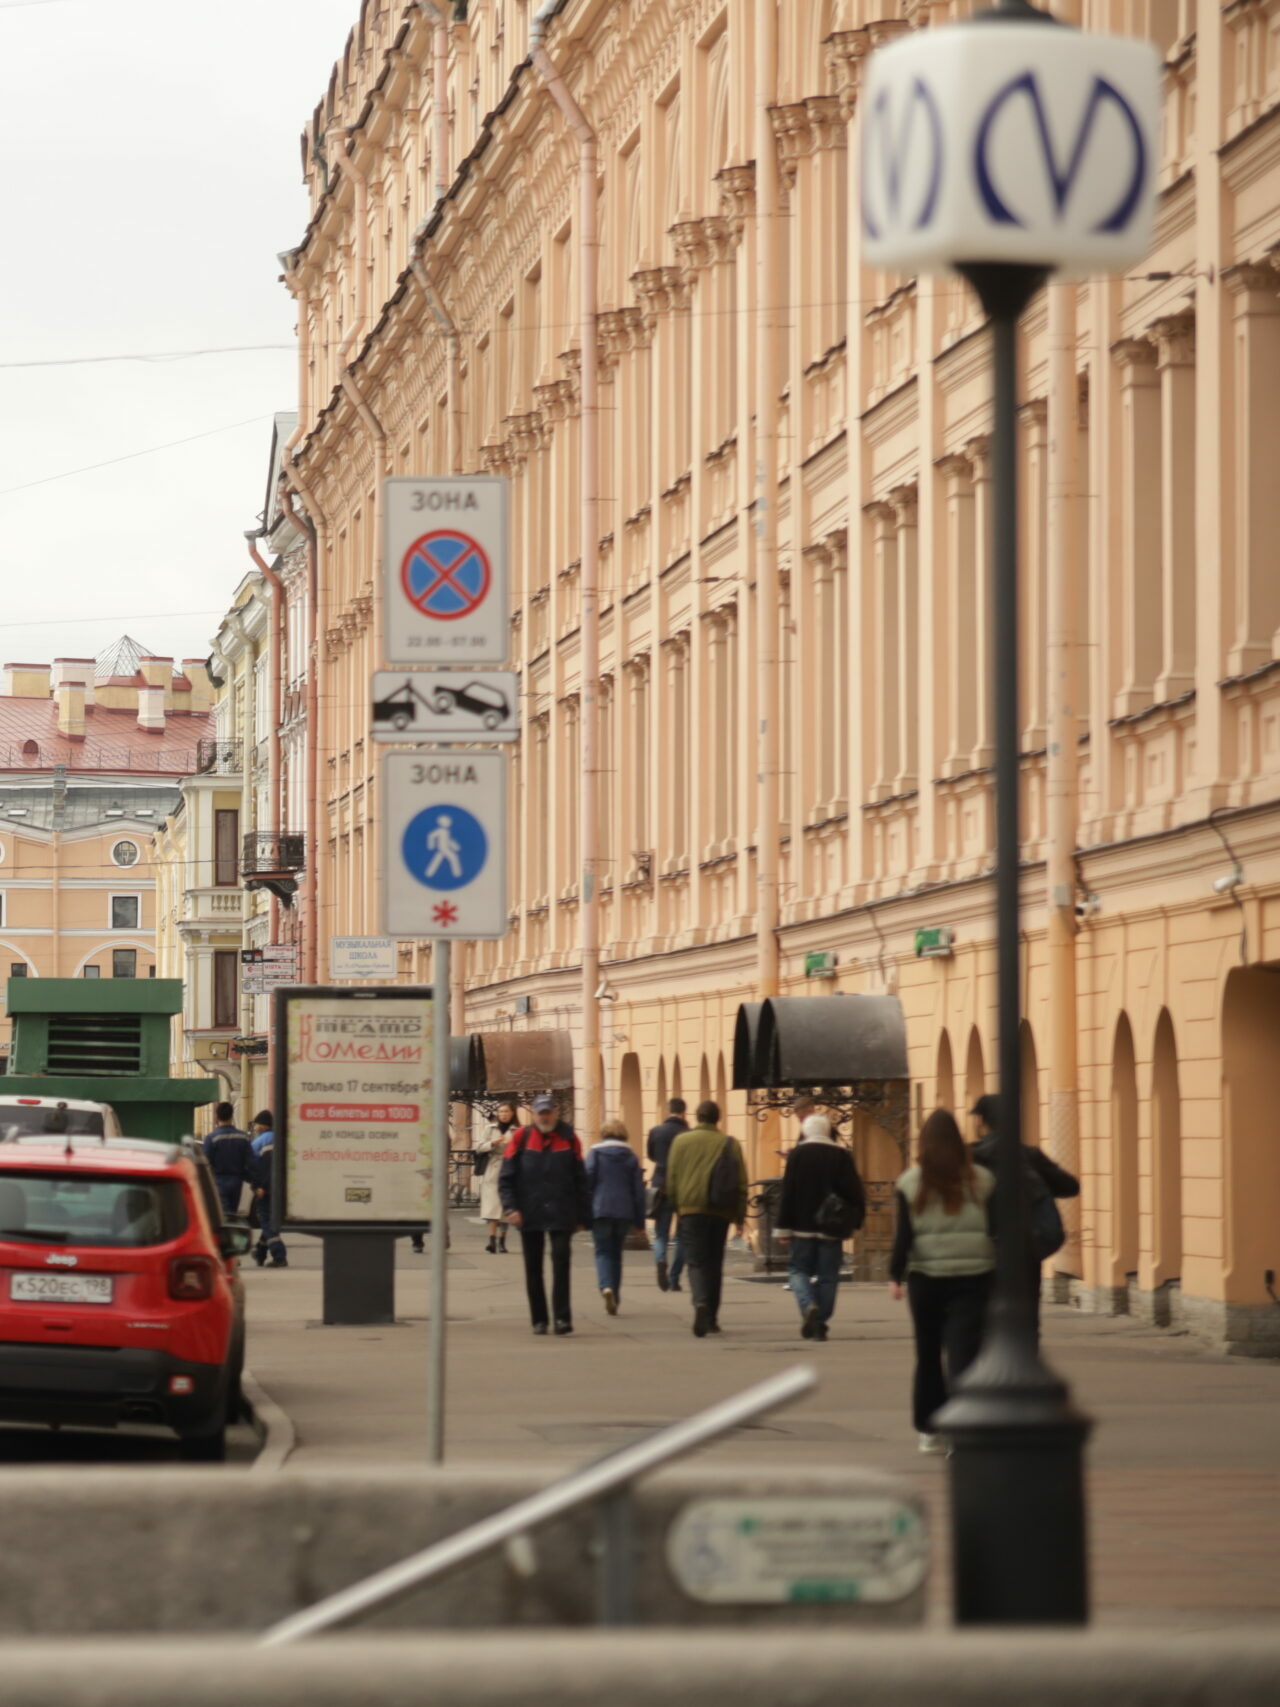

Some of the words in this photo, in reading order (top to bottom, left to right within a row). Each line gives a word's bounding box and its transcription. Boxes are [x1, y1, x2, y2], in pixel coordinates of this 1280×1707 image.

[411, 490, 479, 512] ЗОНА
[411, 764, 478, 785] ЗОНА
[348, 952, 378, 960] ШКОЛА
[300, 1081, 343, 1093] только
[347, 1080, 358, 1092] 17
[361, 1080, 420, 1096] сентября
[305, 1108, 325, 1118] все
[327, 1106, 369, 1119] билеты
[371, 1109, 386, 1119] по
[387, 1108, 414, 1119] 1000
[319, 1130, 332, 1140] до
[335, 1130, 365, 1140] конца
[368, 1130, 399, 1140] осени
[44, 1253, 78, 1267] Jeep
